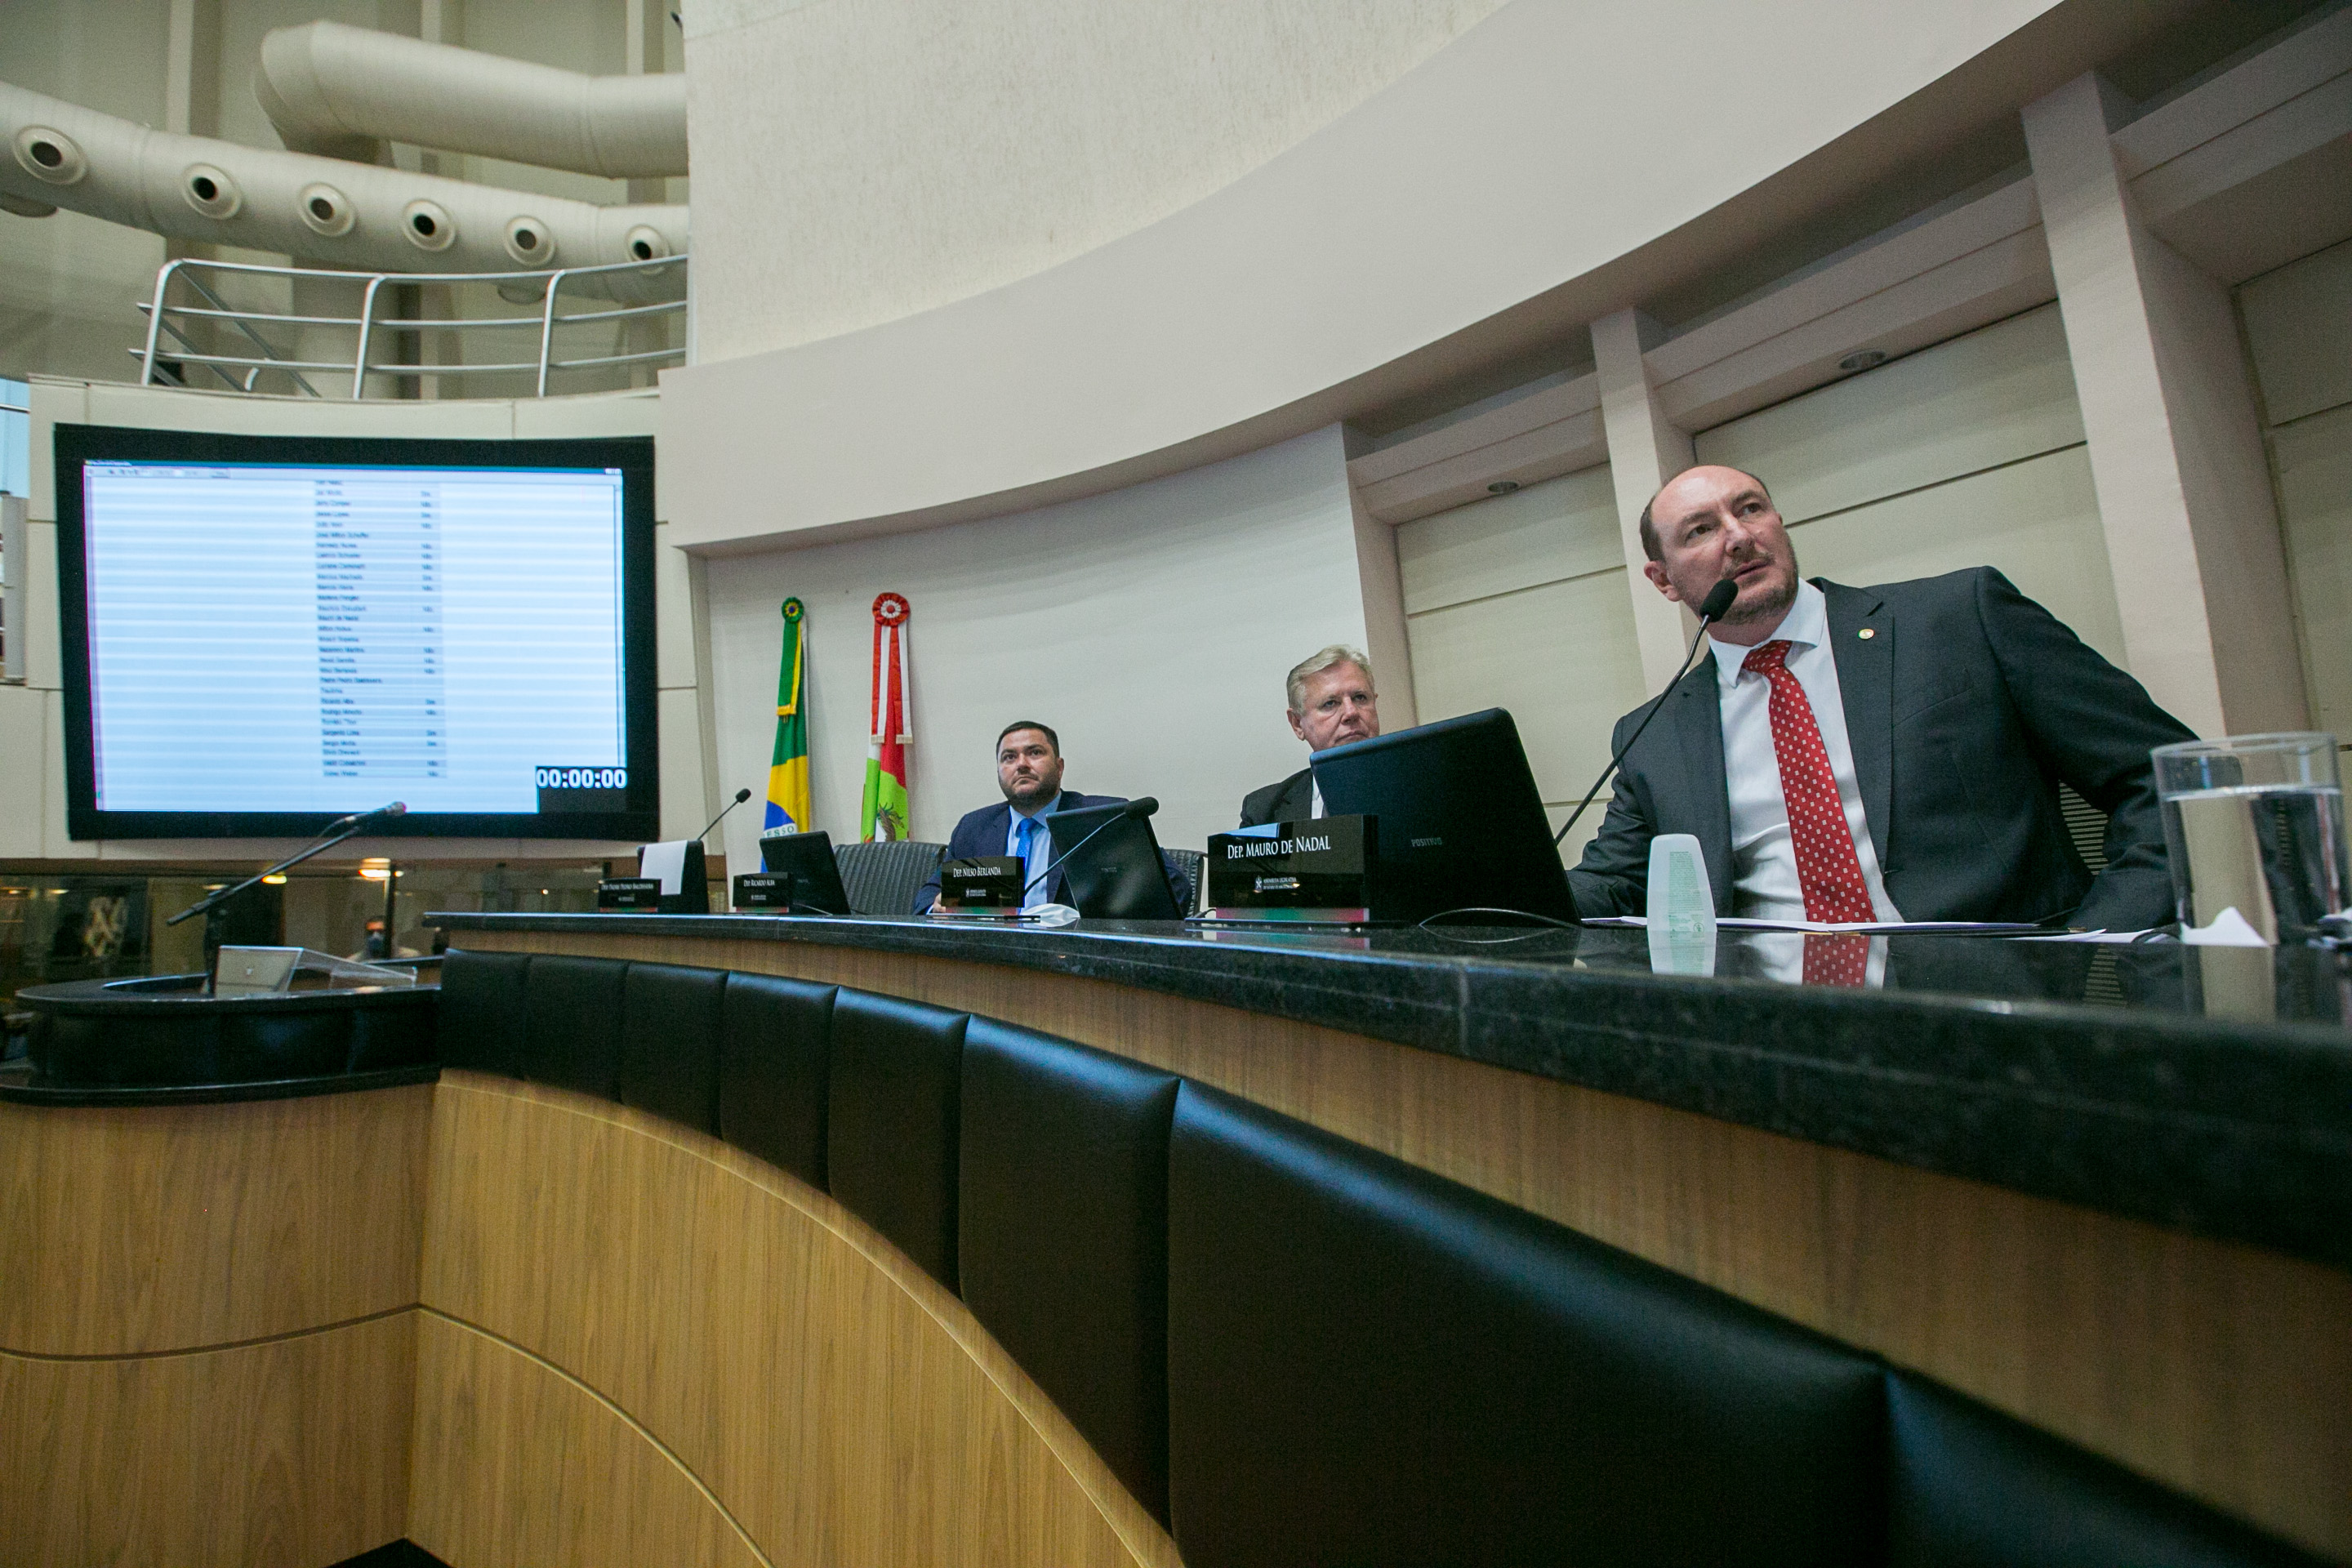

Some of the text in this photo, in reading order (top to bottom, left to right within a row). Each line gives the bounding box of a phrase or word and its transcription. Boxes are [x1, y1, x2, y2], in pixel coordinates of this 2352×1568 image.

[536, 768, 627, 788] 00:00:00
[1245, 841, 1279, 858] MAURO
[1281, 840, 1294, 854] DE
[1296, 835, 1331, 853] NADAL
[977, 866, 1001, 876] BERLANDA
